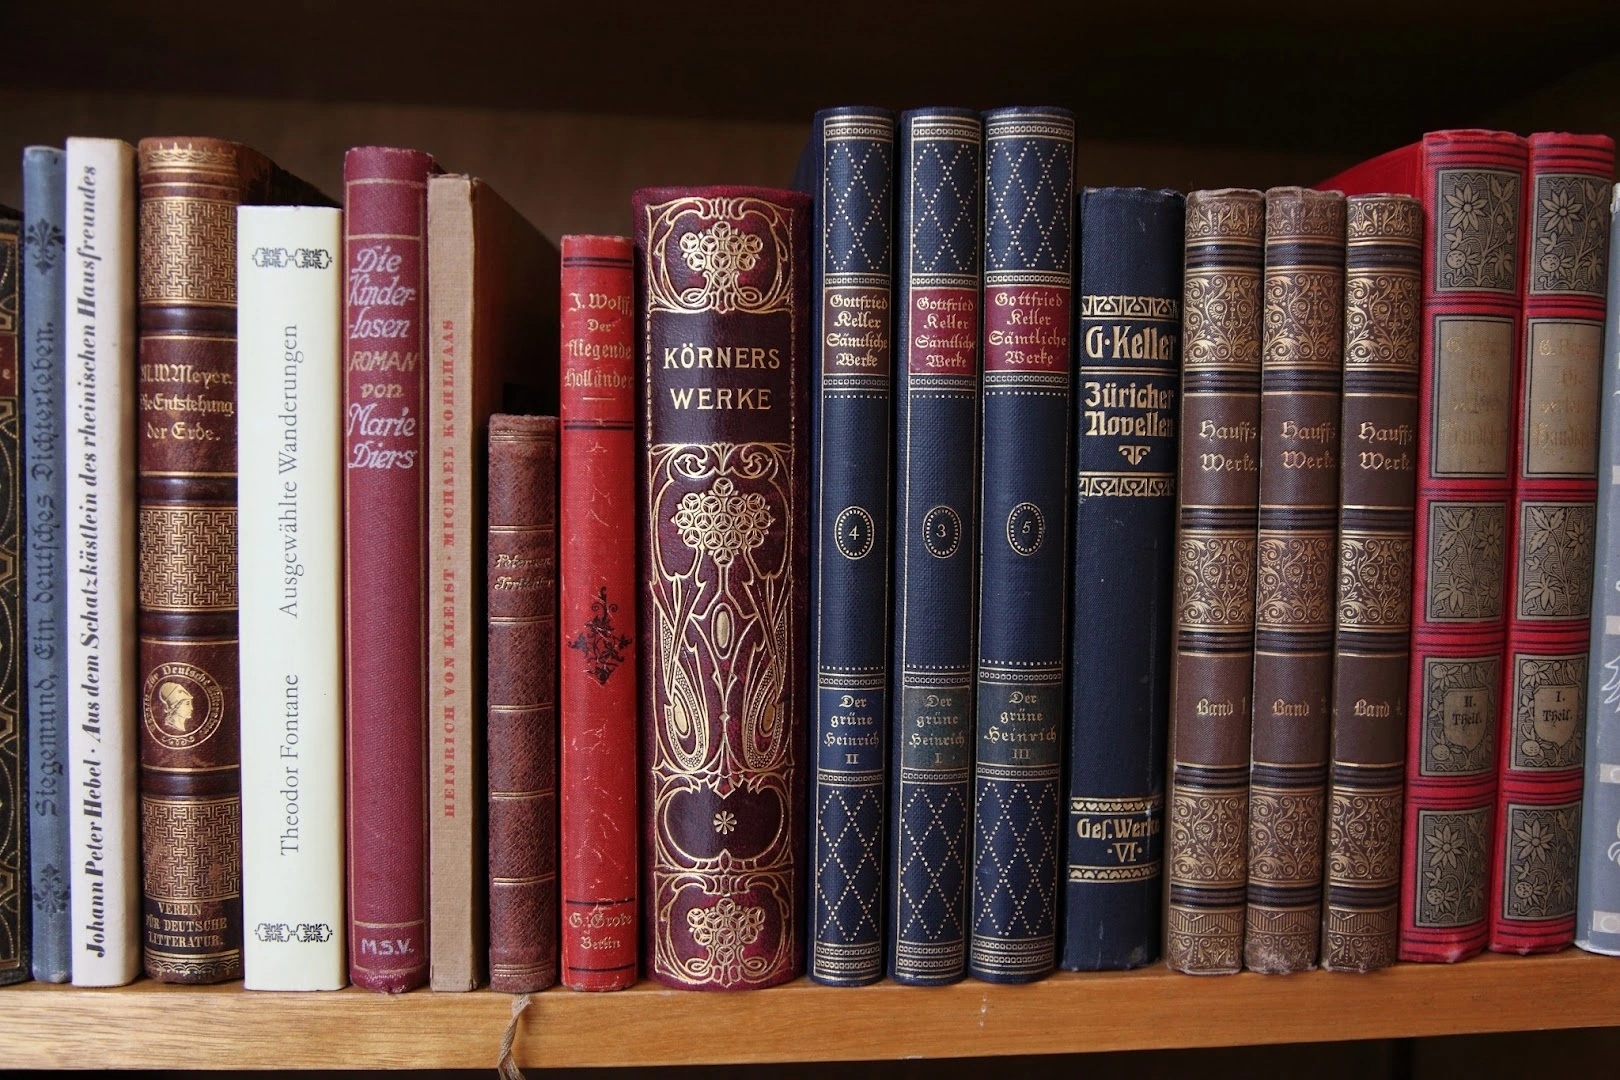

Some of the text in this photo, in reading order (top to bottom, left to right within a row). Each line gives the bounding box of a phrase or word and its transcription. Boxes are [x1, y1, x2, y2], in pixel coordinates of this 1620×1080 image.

[352, 246, 402, 273] Die
[830, 294, 888, 310] Gottfried
[917, 297, 974, 312] Gottfried
[995, 291, 1063, 307] Gottfried
[587, 319, 612, 332] Der
[834, 311, 882, 329] Keller
[923, 313, 968, 329] Keller
[1007, 308, 1051, 325] Keller
[826, 331, 888, 352] Sämtliche
[915, 334, 976, 352] Sämtliche
[989, 327, 1067, 347] Sämtliche
[564, 339, 632, 360] fliegende
[663, 343, 781, 369] KÖRNERS
[836, 349, 878, 367] Werke
[1005, 346, 1053, 365] Werke
[350, 351, 418, 372] ROMAN
[926, 351, 967, 368] Werke
[360, 382, 405, 399] von
[670, 388, 772, 410] WERKE
[30, 322, 59, 481] Dichterleben.
[153, 393, 235, 417] Entstehung
[348, 402, 416, 437] Marie
[1084, 410, 1174, 437] Novellen
[147, 422, 168, 440] der
[348, 441, 417, 469] Diers
[278, 324, 304, 618] Ausgewählte Wanderungen
[849, 526, 860, 541] 4
[936, 524, 947, 538] 3
[1022, 520, 1033, 534] 5
[76, 165, 105, 958] Johann Peter Hebel Aus dem Schatzkästlein des rheinischen Hausfreundes
[442, 320, 455, 818] HEINRICH VON KLEIST MICHAEL KOHLHAAS
[33, 618, 55, 660] Ein
[839, 694, 868, 708] Der
[925, 694, 953, 708] Der
[1009, 691, 1038, 704] Der
[1000, 708, 1043, 724] grüne
[1197, 698, 1234, 717] Band
[1272, 698, 1310, 717] Band
[1353, 698, 1391, 718] Band
[830, 712, 874, 728] grüne
[916, 712, 959, 728] grüne
[824, 731, 880, 748] Heinrich
[909, 730, 965, 748] Heinrich
[983, 725, 1057, 744] Heinrich
[845, 753, 860, 765] II
[934, 753, 942, 763] I
[1012, 748, 1031, 760] III
[280, 674, 298, 856] Theodor Fontane
[158, 902, 202, 916] VEREIN
[163, 918, 228, 933] DEUTSCHE
[580, 936, 620, 950] Berlin
